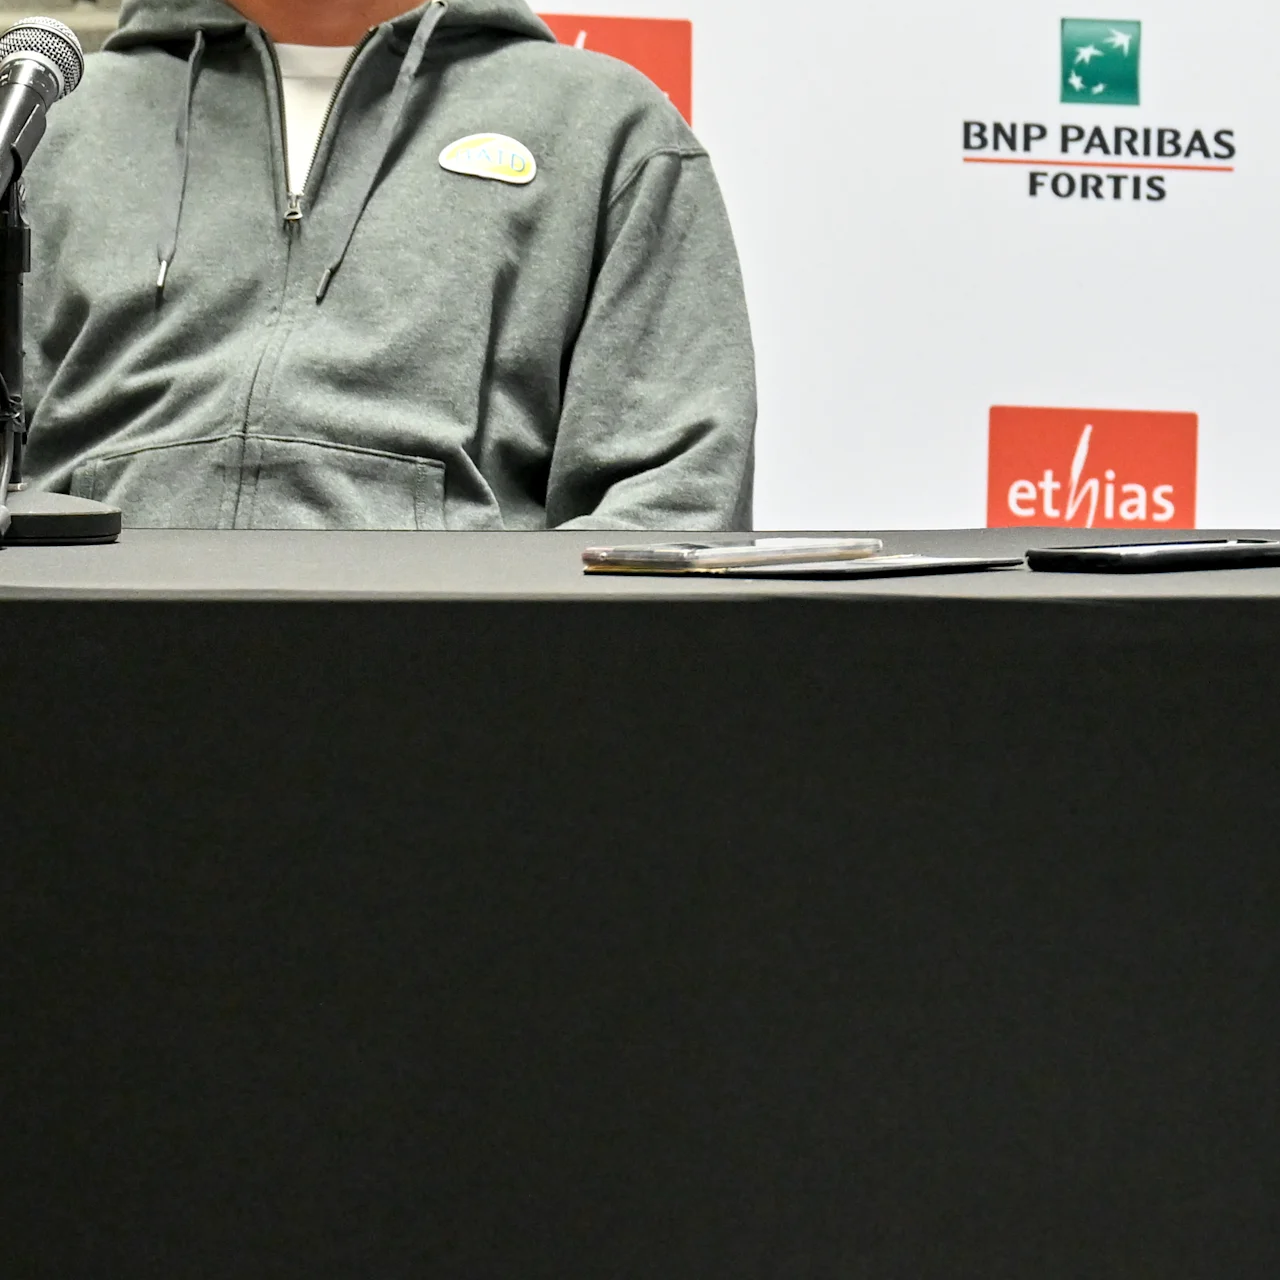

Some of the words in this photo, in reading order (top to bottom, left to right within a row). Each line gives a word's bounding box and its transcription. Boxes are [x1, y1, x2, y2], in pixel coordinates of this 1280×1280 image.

[963, 120, 1048, 153] BNP
[1060, 124, 1236, 160] PARIBAS
[1028, 171, 1167, 202] FORTIS
[1008, 424, 1175, 529] ethias
